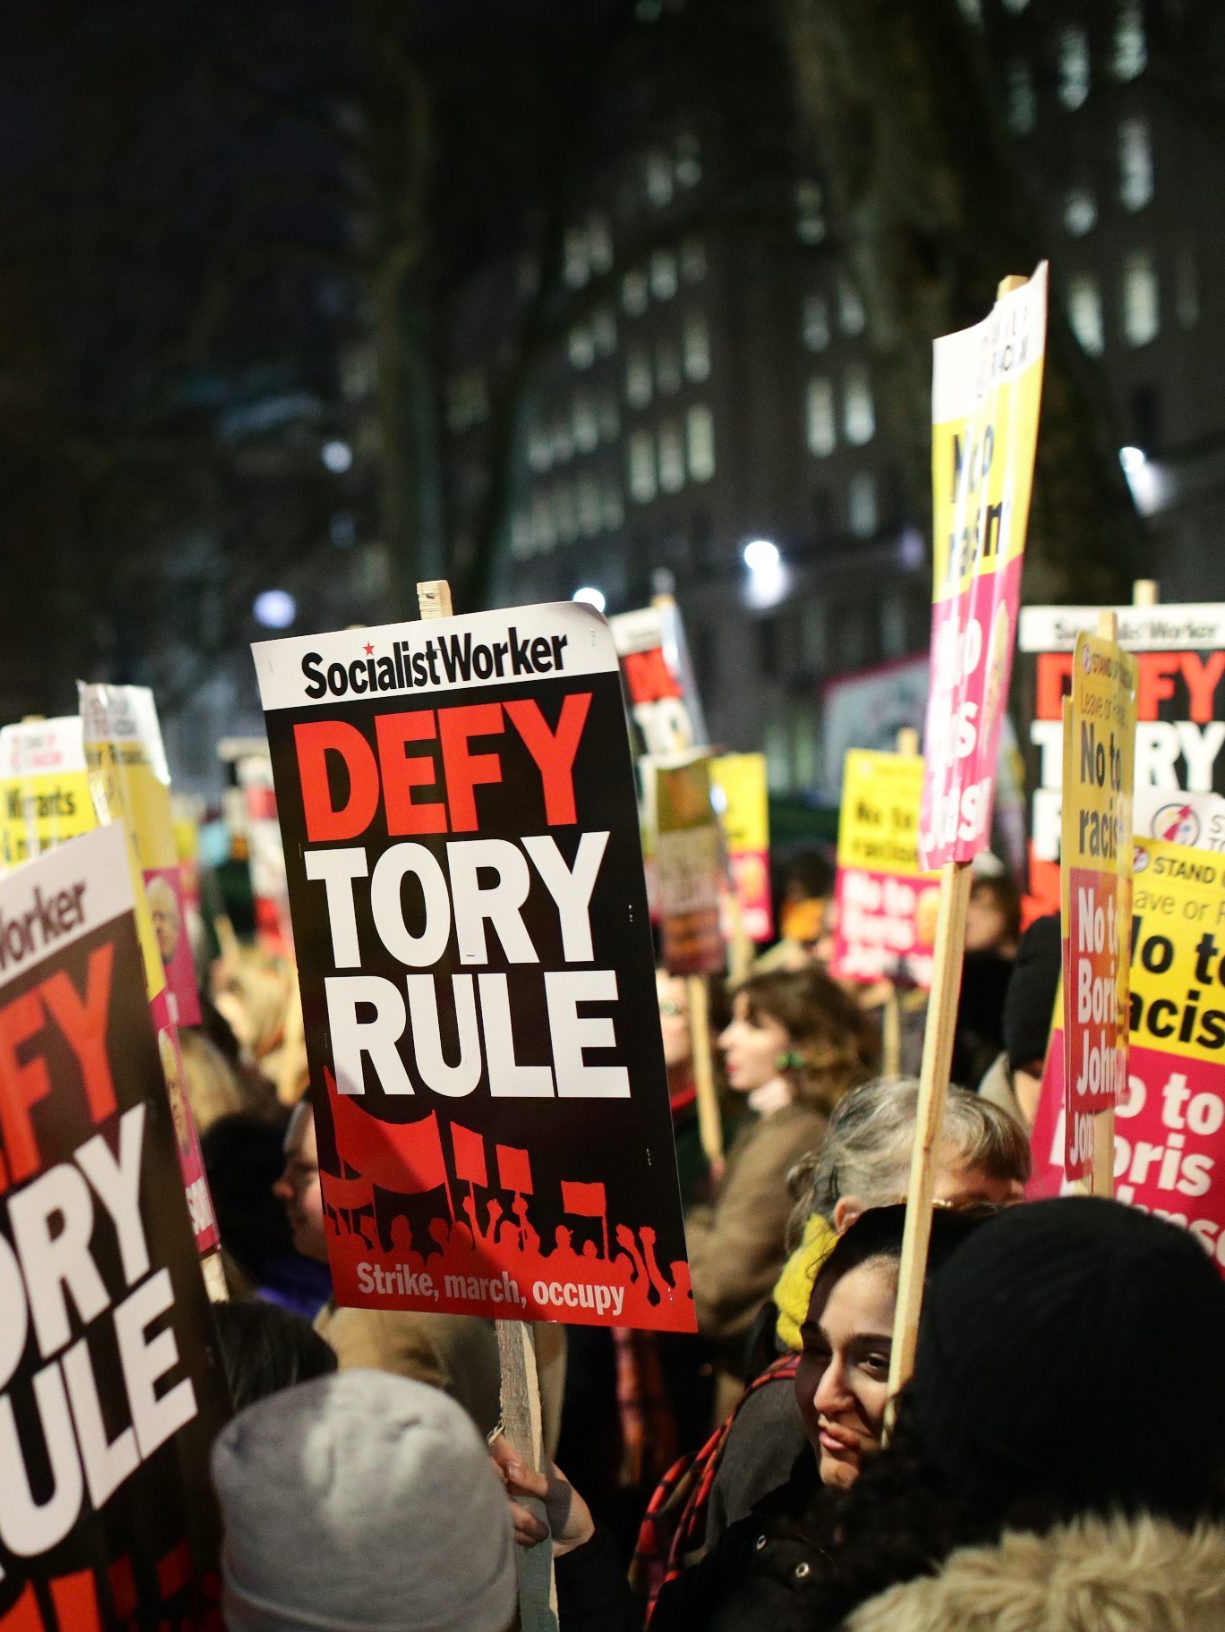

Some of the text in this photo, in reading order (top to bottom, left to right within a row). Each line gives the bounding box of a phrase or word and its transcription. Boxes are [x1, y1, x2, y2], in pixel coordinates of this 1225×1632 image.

[1036, 651, 1225, 723] DFY
[292, 691, 594, 843] DEFY
[1030, 719, 1225, 794] TRY
[1080, 719, 1105, 788] No
[304, 830, 611, 969] TORY
[1153, 855, 1216, 885] STAND
[1077, 887, 1104, 954] No
[1134, 890, 1176, 916] ave
[1183, 900, 1209, 923] or
[1077, 957, 1118, 1026] Bori
[323, 969, 631, 1099] RULE
[1161, 1071, 1225, 1136] to
[357, 1261, 626, 1316] Strike, march, occupy
